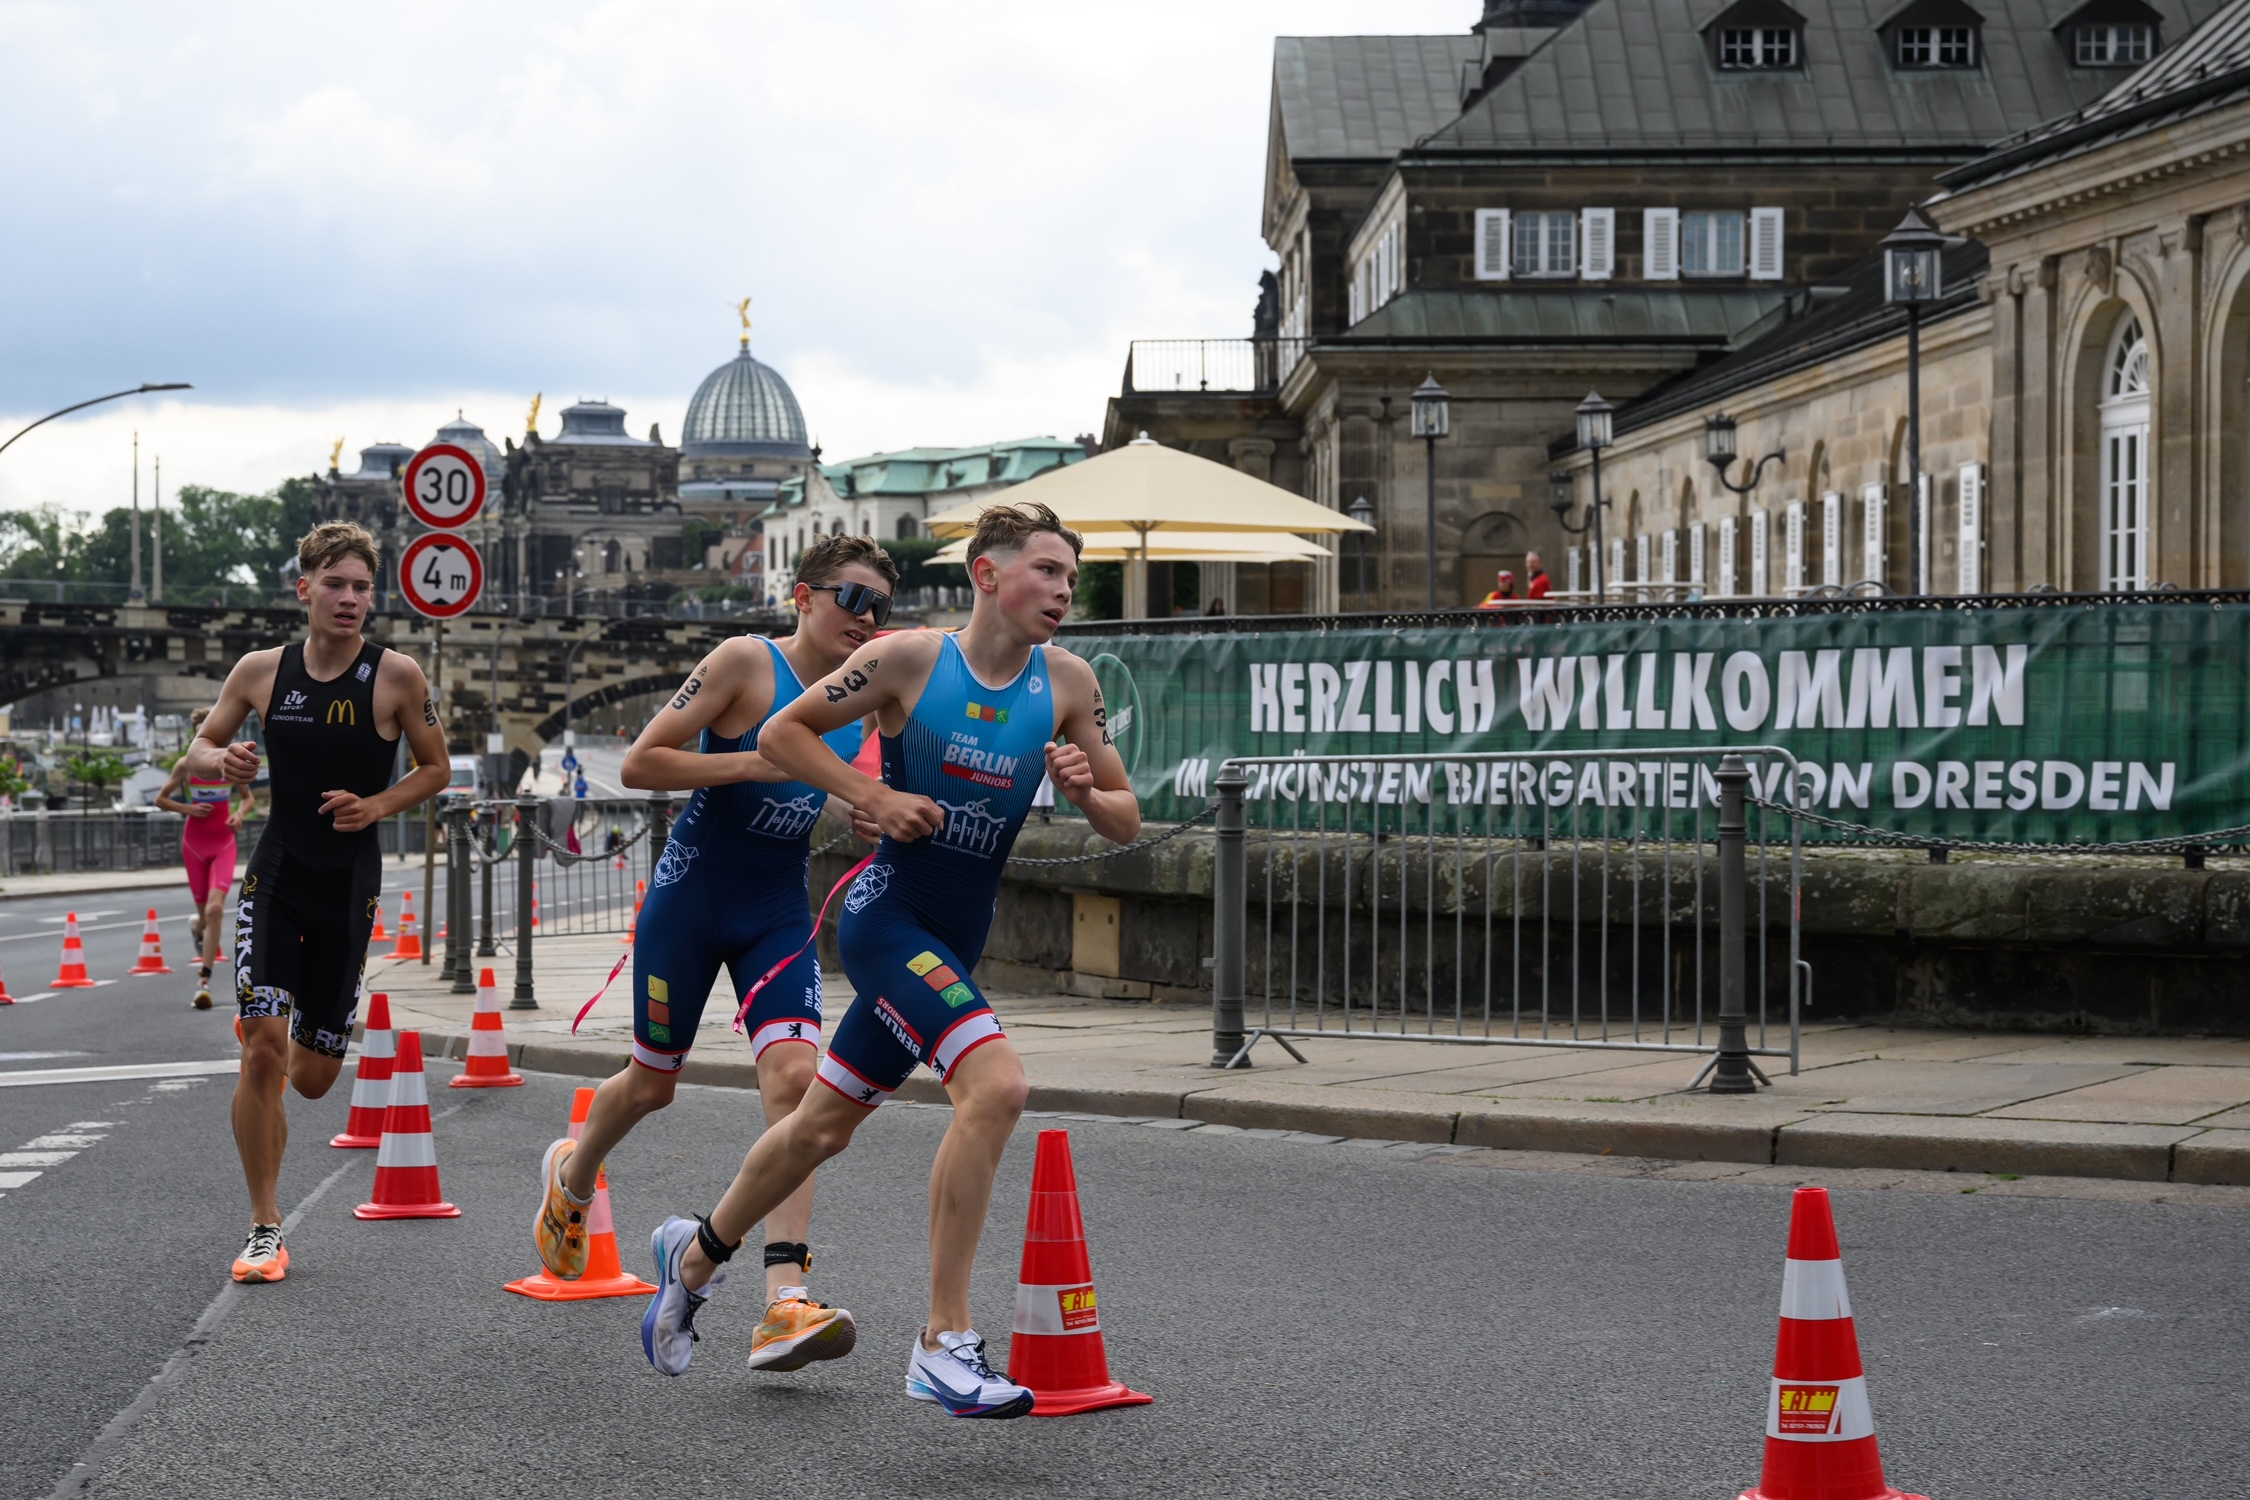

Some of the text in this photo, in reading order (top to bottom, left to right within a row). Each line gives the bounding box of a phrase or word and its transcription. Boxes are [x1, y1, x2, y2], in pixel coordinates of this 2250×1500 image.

[421, 466, 468, 506] 30
[422, 556, 466, 591] 4 m
[283, 690, 308, 705] LTV
[671, 678, 702, 710] 35
[826, 669, 869, 704] 34
[1249, 644, 2028, 734] HERZLICH WILLKOMMEN
[271, 714, 314, 723] JUNIORTEAM
[423, 699, 437, 727] 65
[1093, 707, 1114, 747] 34
[950, 731, 979, 746] TEAM
[943, 743, 1019, 777] BERLIN
[969, 771, 1013, 789] JUNIORS
[1174, 748, 2176, 811] IM CHÖNSTEN BIERGARTEN VON DRESDEN
[952, 823, 985, 840] BTU
[804, 986, 814, 1008] TEAM
[876, 996, 909, 1028] JUNIORS
[873, 1005, 922, 1059] BERLIN
